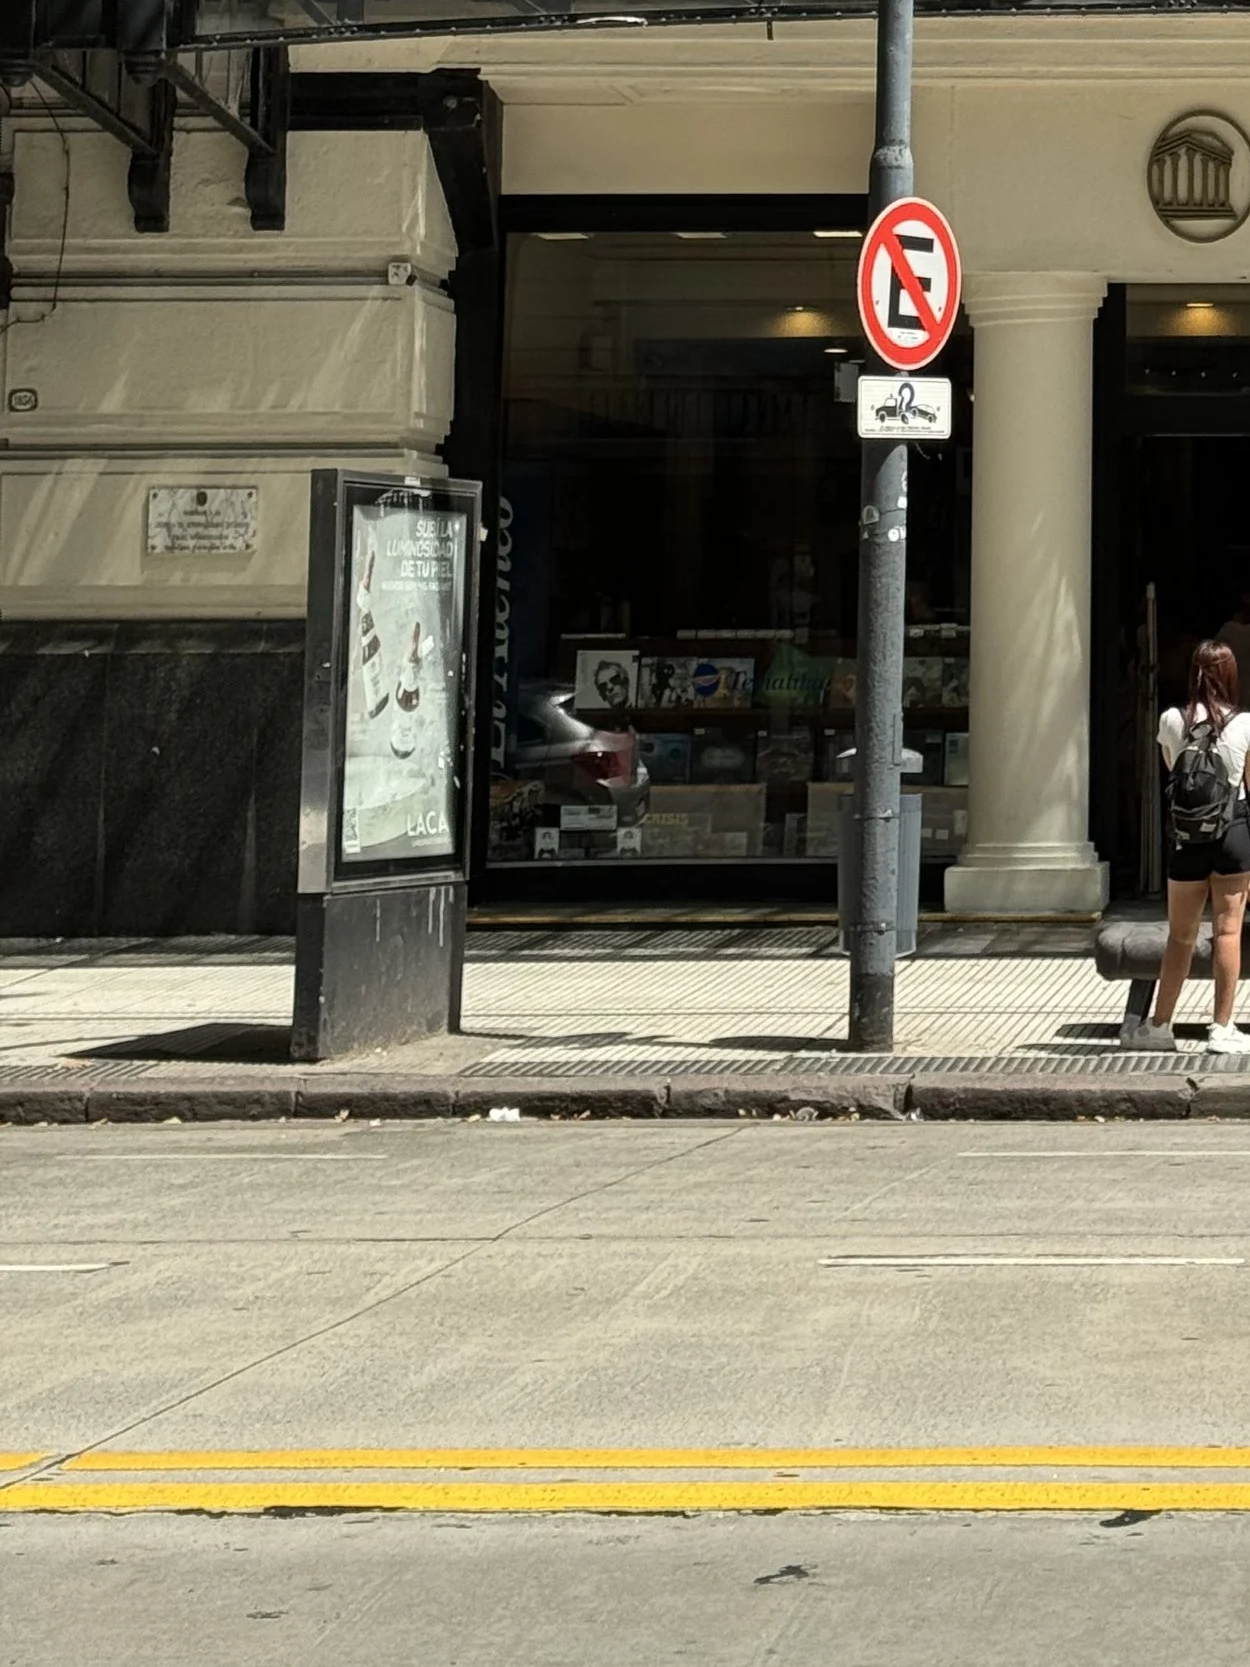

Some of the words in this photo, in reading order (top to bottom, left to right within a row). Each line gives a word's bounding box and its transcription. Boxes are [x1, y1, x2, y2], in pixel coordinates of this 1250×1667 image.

[887, 233, 935, 331] E
[401, 560, 414, 578] DE
[415, 560, 429, 578] TU
[407, 811, 450, 837] LACA
